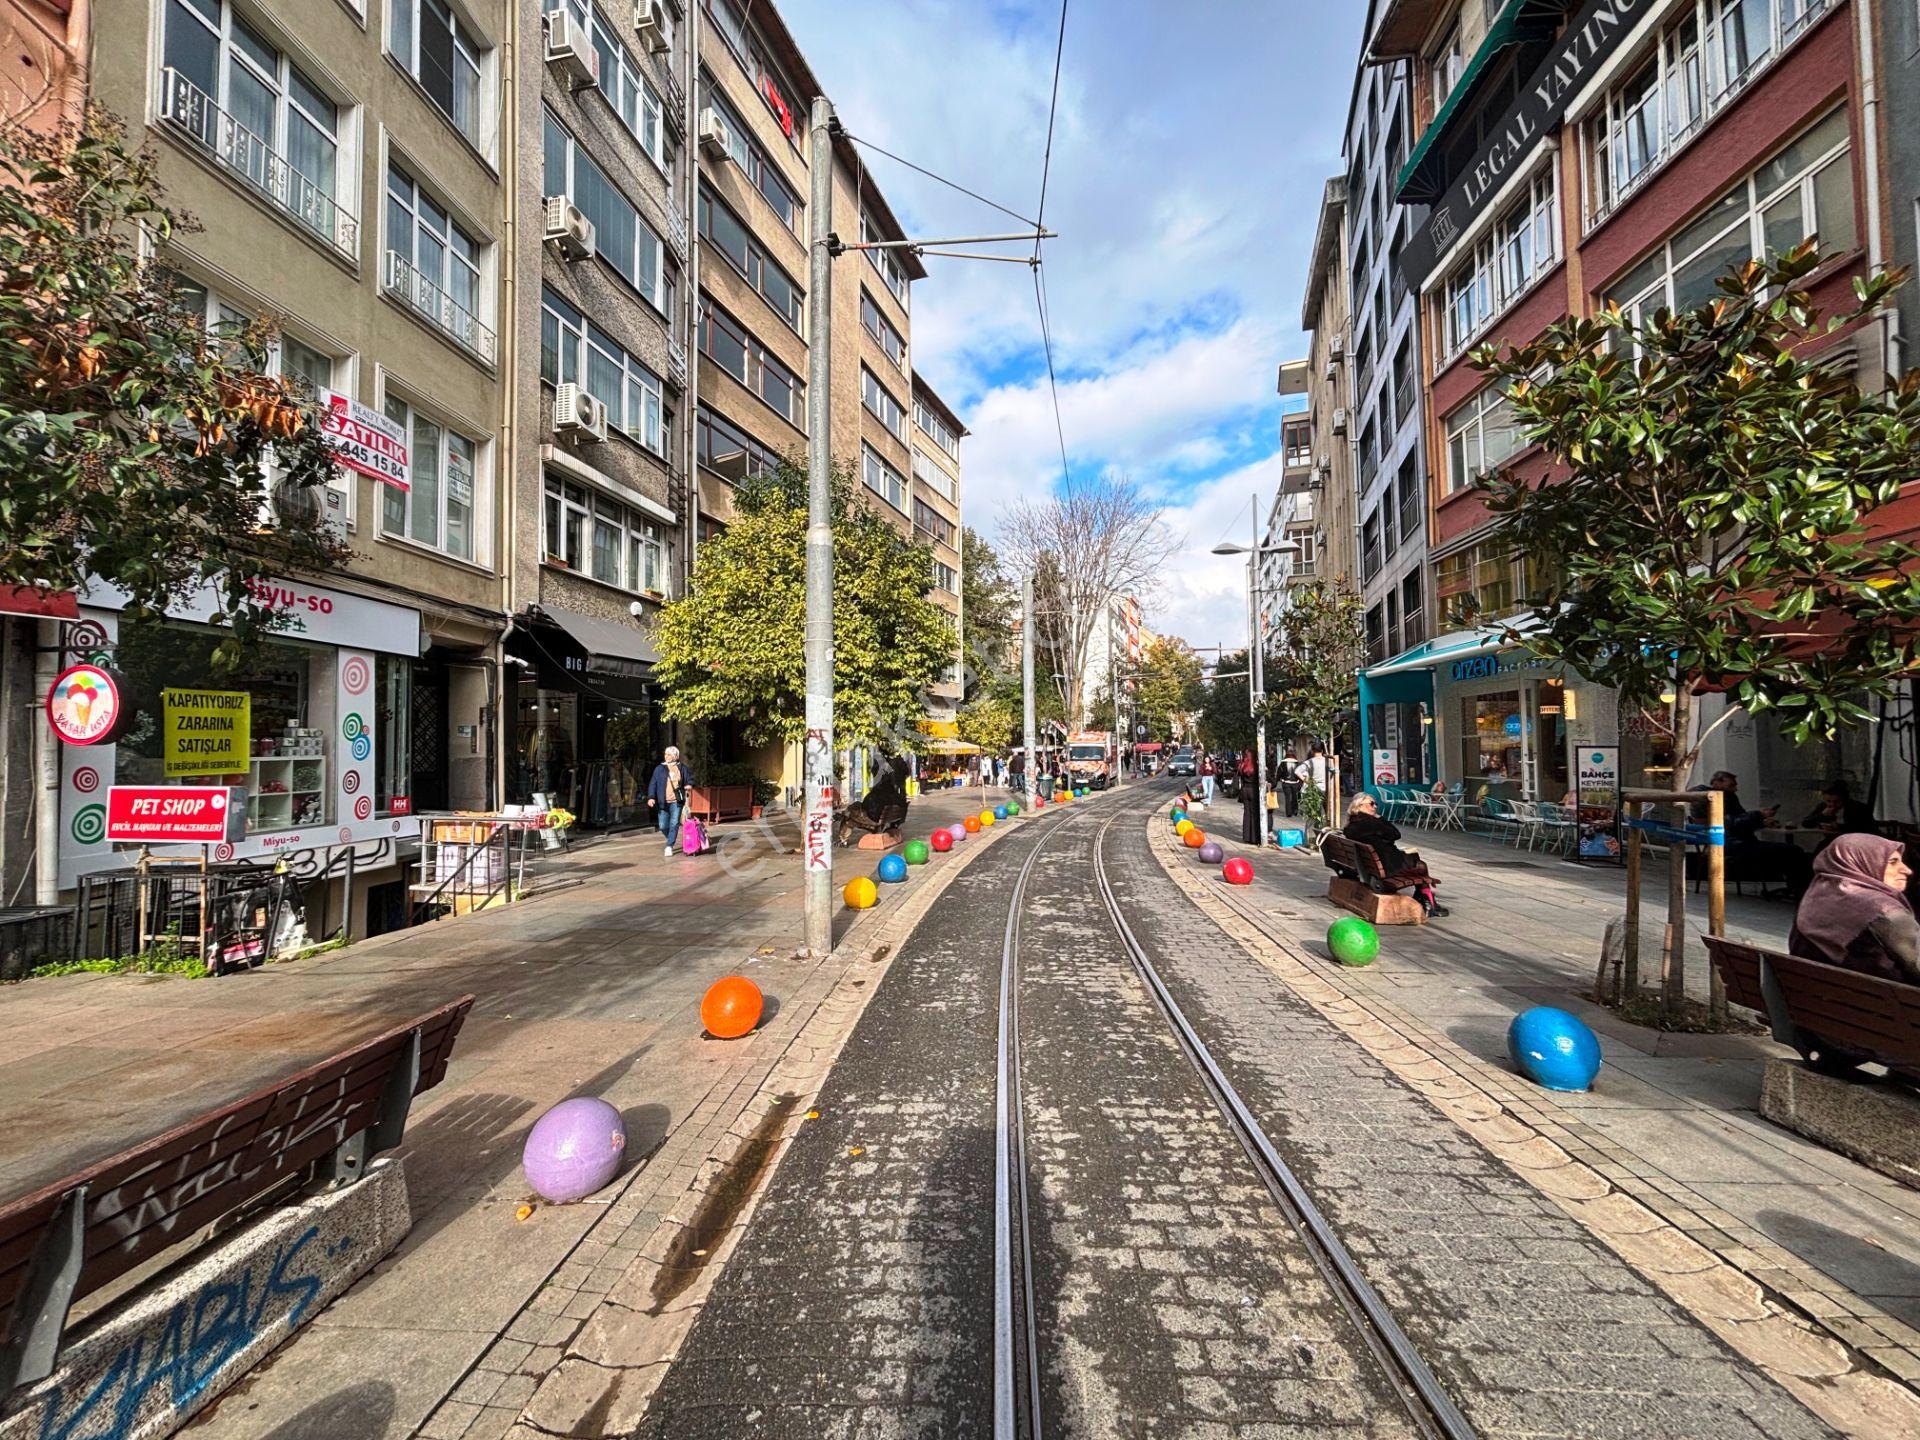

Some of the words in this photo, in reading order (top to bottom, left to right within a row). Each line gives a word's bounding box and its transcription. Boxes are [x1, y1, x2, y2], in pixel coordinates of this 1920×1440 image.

[1462, 111, 1536, 208] LEGAL
[324, 414, 406, 464] SATILIK
[341, 440, 368, 463] 445
[373, 454, 388, 472] 15
[391, 462, 405, 480] 84
[565, 656, 582, 671] BIG
[1452, 655, 1497, 680] arzen
[168, 692, 245, 710] KAPATIYORUZ
[177, 716, 234, 731] ZARARINA
[178, 738, 232, 755] SATIŞLAR
[1581, 771, 1616, 779] BAHÇE
[131, 798, 160, 815] PET
[161, 799, 206, 816] SHOP
[393, 799, 407, 809] HH
[162, 823, 173, 831] VE
[263, 835, 300, 847] Miyu-so
